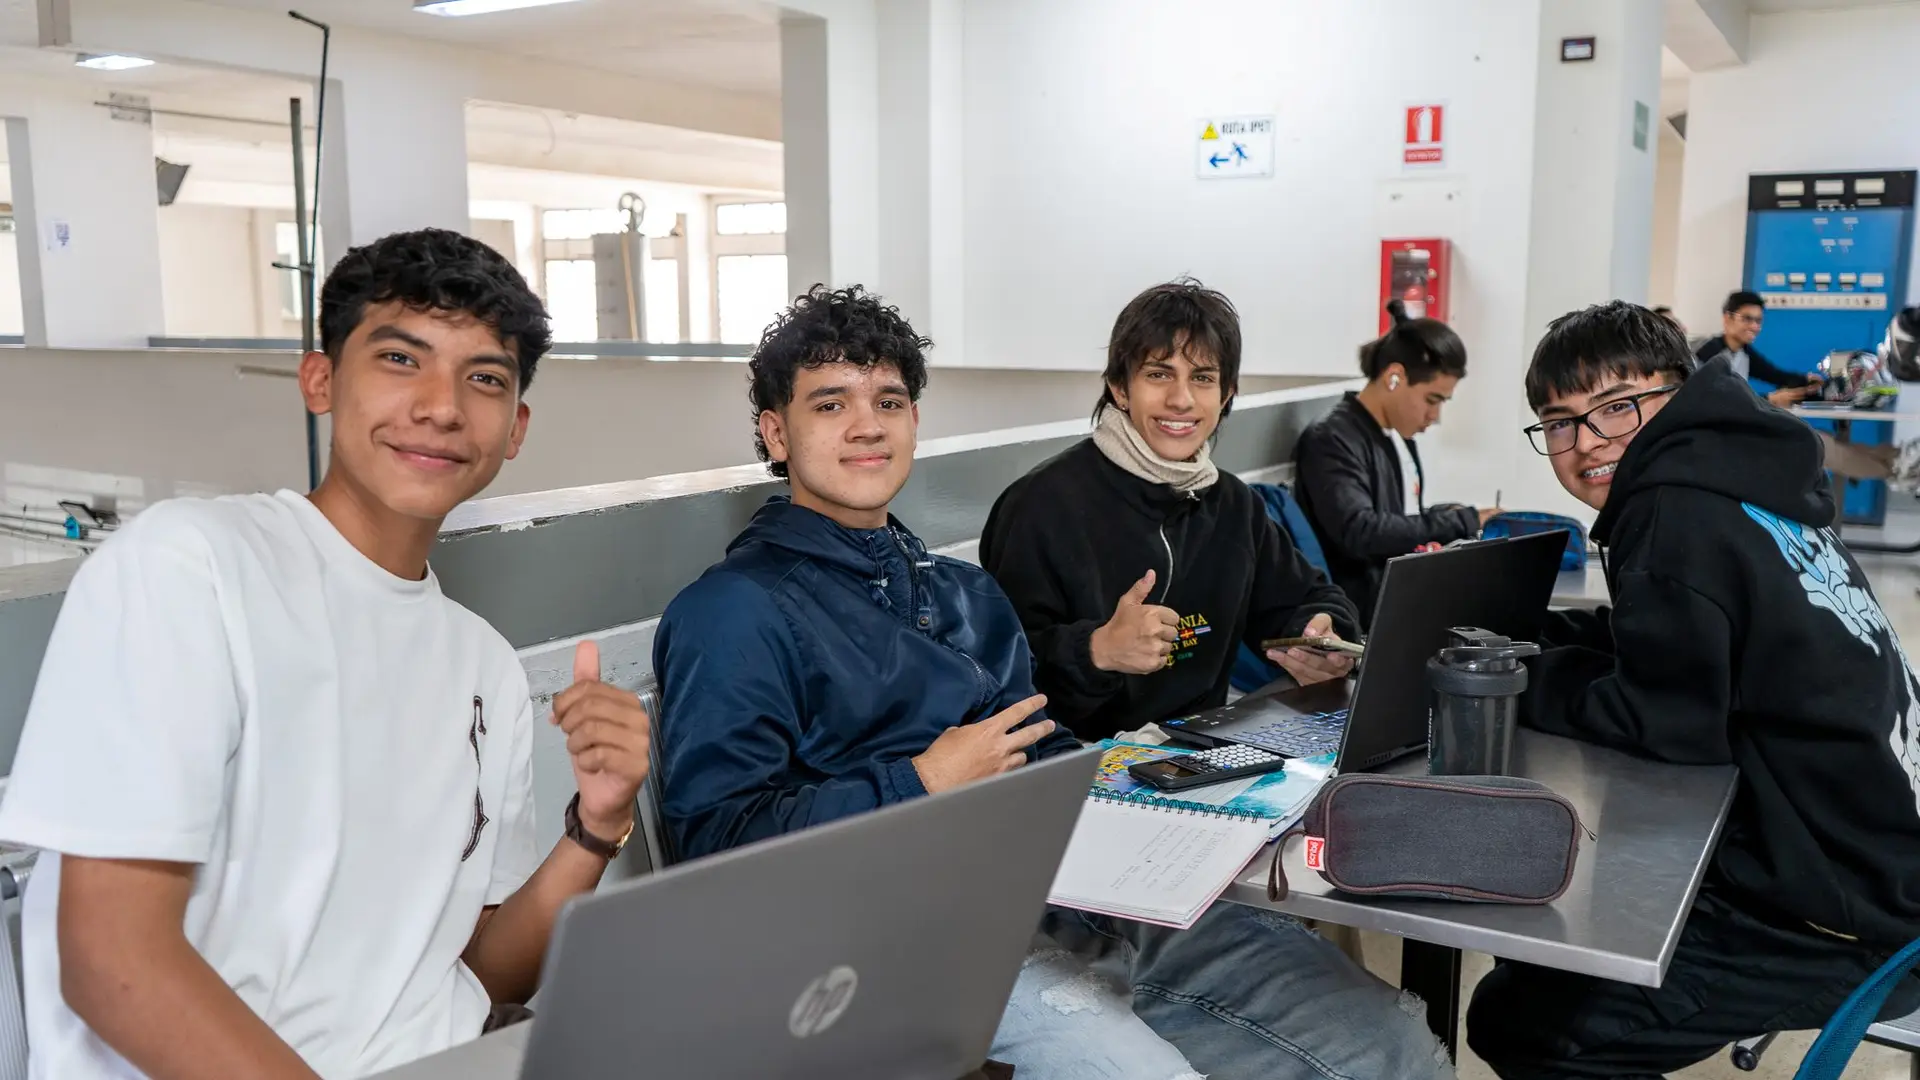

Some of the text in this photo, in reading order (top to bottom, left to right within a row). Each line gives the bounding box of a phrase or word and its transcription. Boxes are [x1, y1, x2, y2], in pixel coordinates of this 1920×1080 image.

[1175, 613, 1208, 630] NIA
[1182, 637, 1198, 648] BAY
[791, 968, 856, 1036] hp
